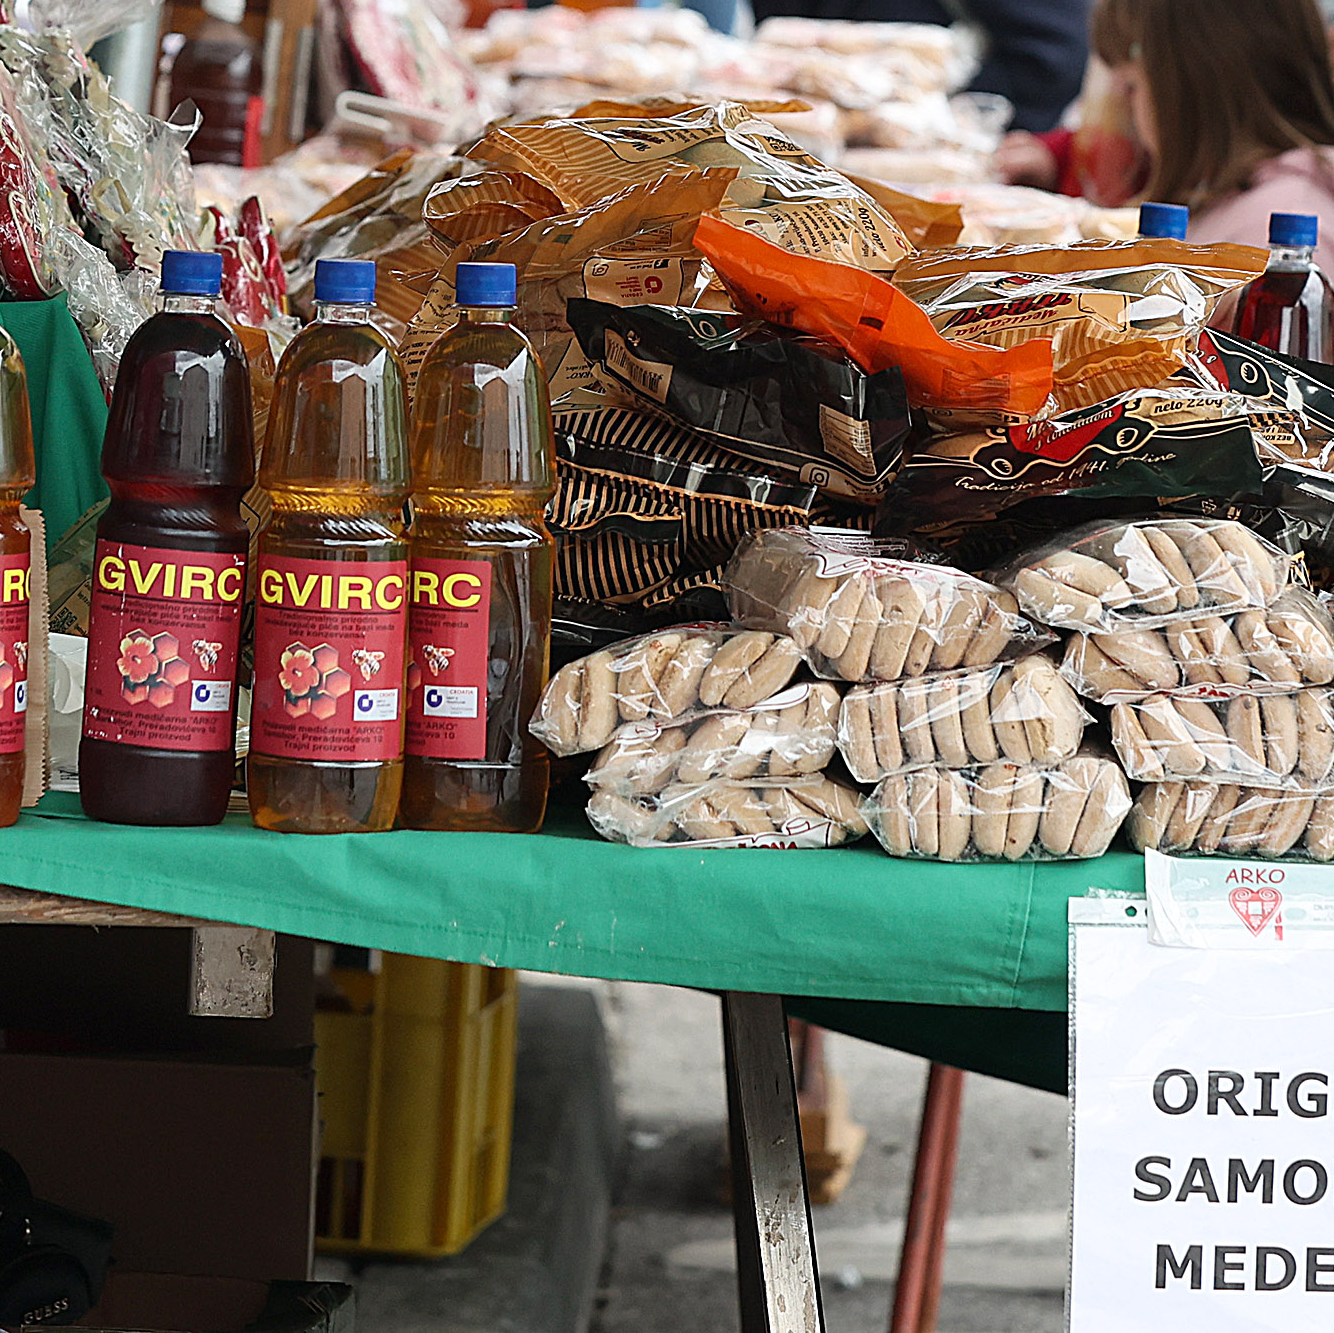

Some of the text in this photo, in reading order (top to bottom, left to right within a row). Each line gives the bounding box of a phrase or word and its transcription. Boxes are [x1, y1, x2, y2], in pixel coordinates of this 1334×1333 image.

[1153, 401, 1182, 415] neto
[953, 475, 1035, 491] Tradicija
[1041, 471, 1064, 486] od
[1067, 459, 1110, 480] 1941.
[97, 555, 242, 602] GVIRC
[260, 569, 404, 610] GVIRC
[1225, 867, 1285, 885] ARKO
[23, 1296, 70, 1325] GUESS
